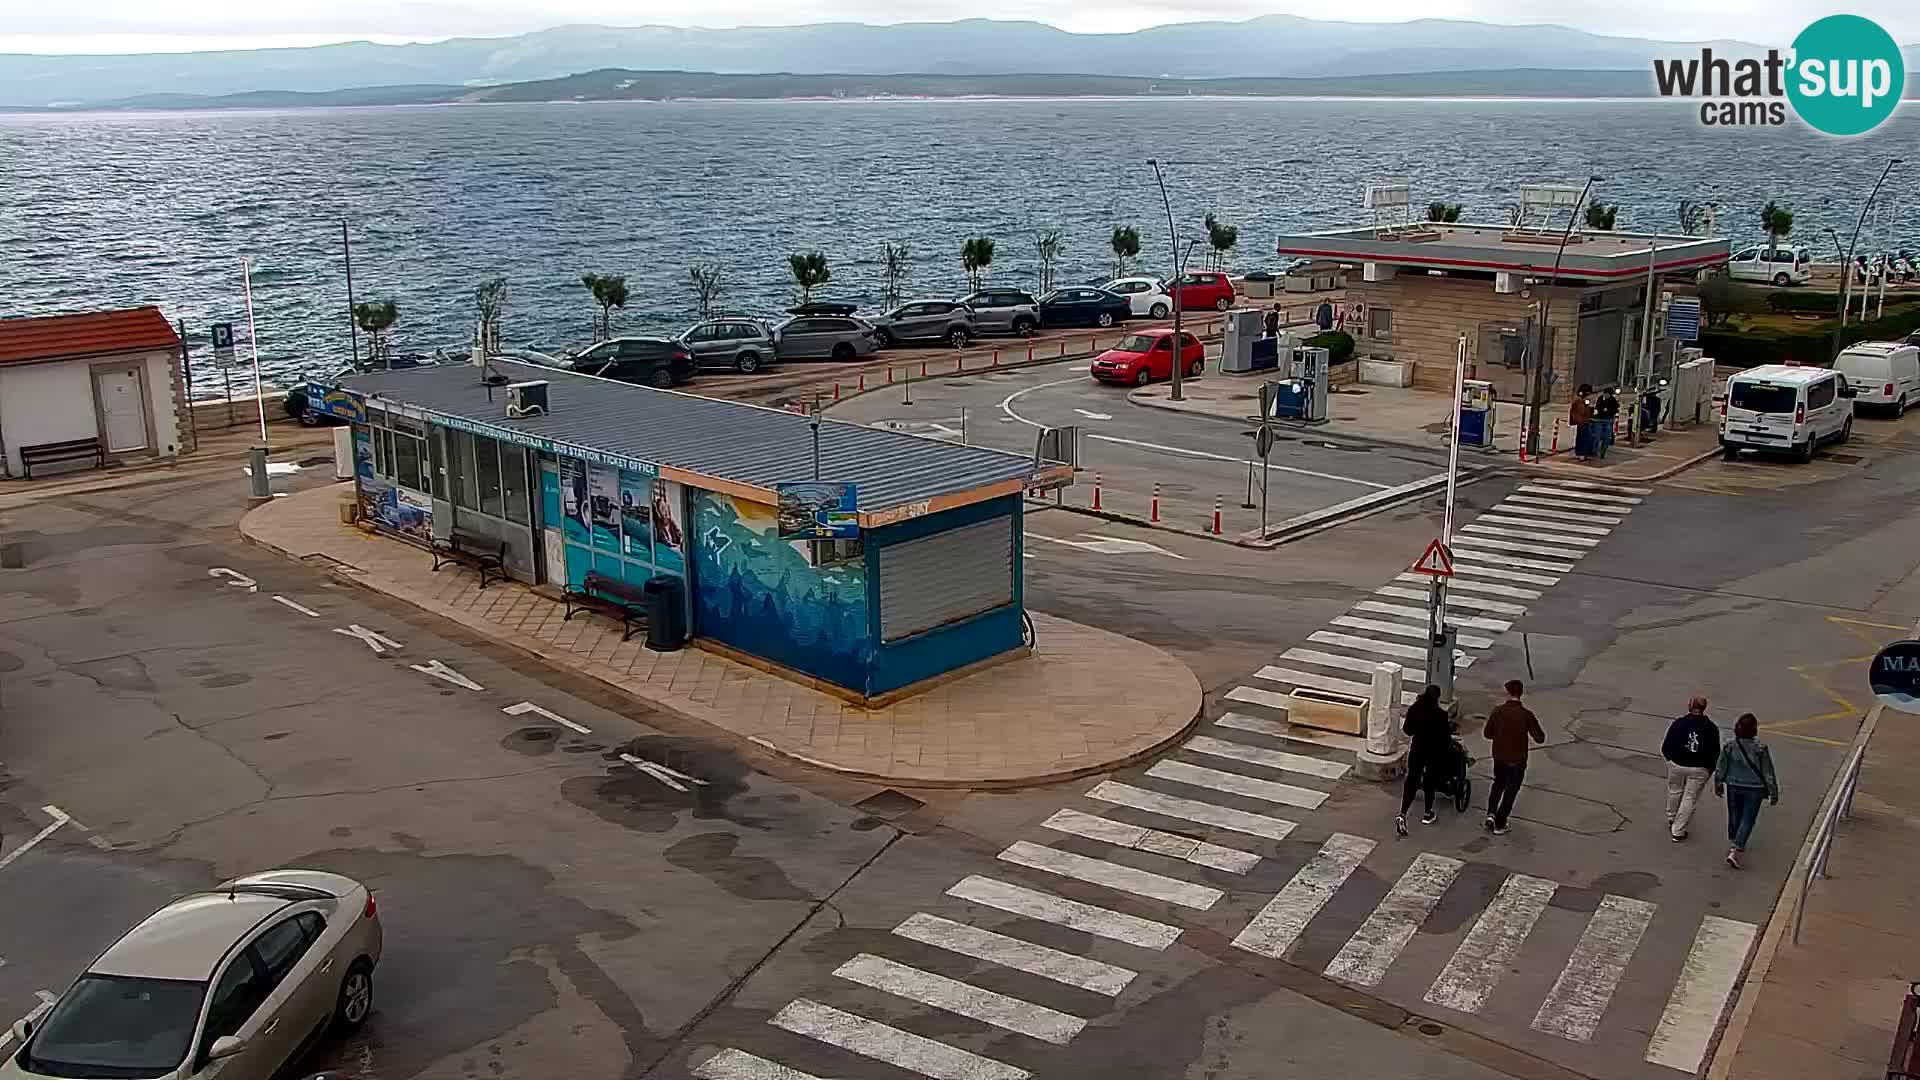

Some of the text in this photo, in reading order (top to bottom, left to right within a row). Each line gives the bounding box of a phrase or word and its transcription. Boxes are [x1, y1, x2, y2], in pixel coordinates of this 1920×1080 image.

[553, 442, 568, 454] BUS
[568, 446, 600, 461] STATION
[602, 454, 628, 469] TICKET
[628, 460, 655, 475] OFFICE
